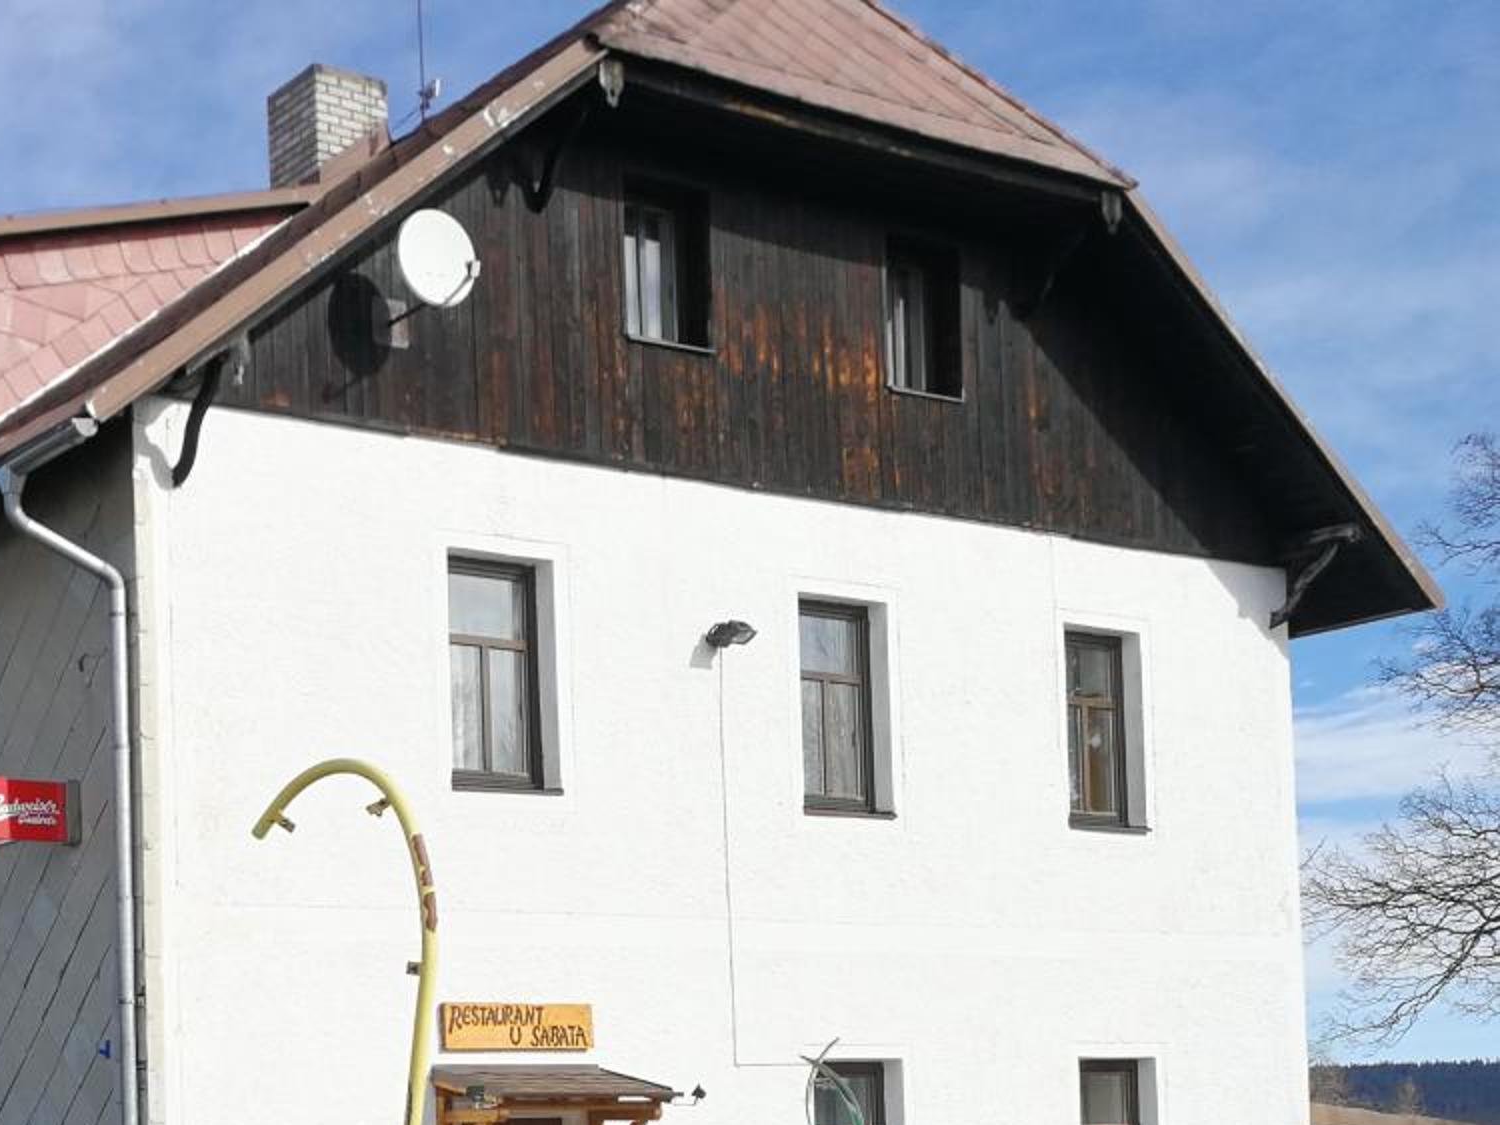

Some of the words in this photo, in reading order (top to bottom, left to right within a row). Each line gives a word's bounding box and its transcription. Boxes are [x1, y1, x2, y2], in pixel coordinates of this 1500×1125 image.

[449, 1005, 544, 1034] RESTAURANT
[509, 1026, 521, 1046] U
[530, 1025, 589, 1047] SABATA
